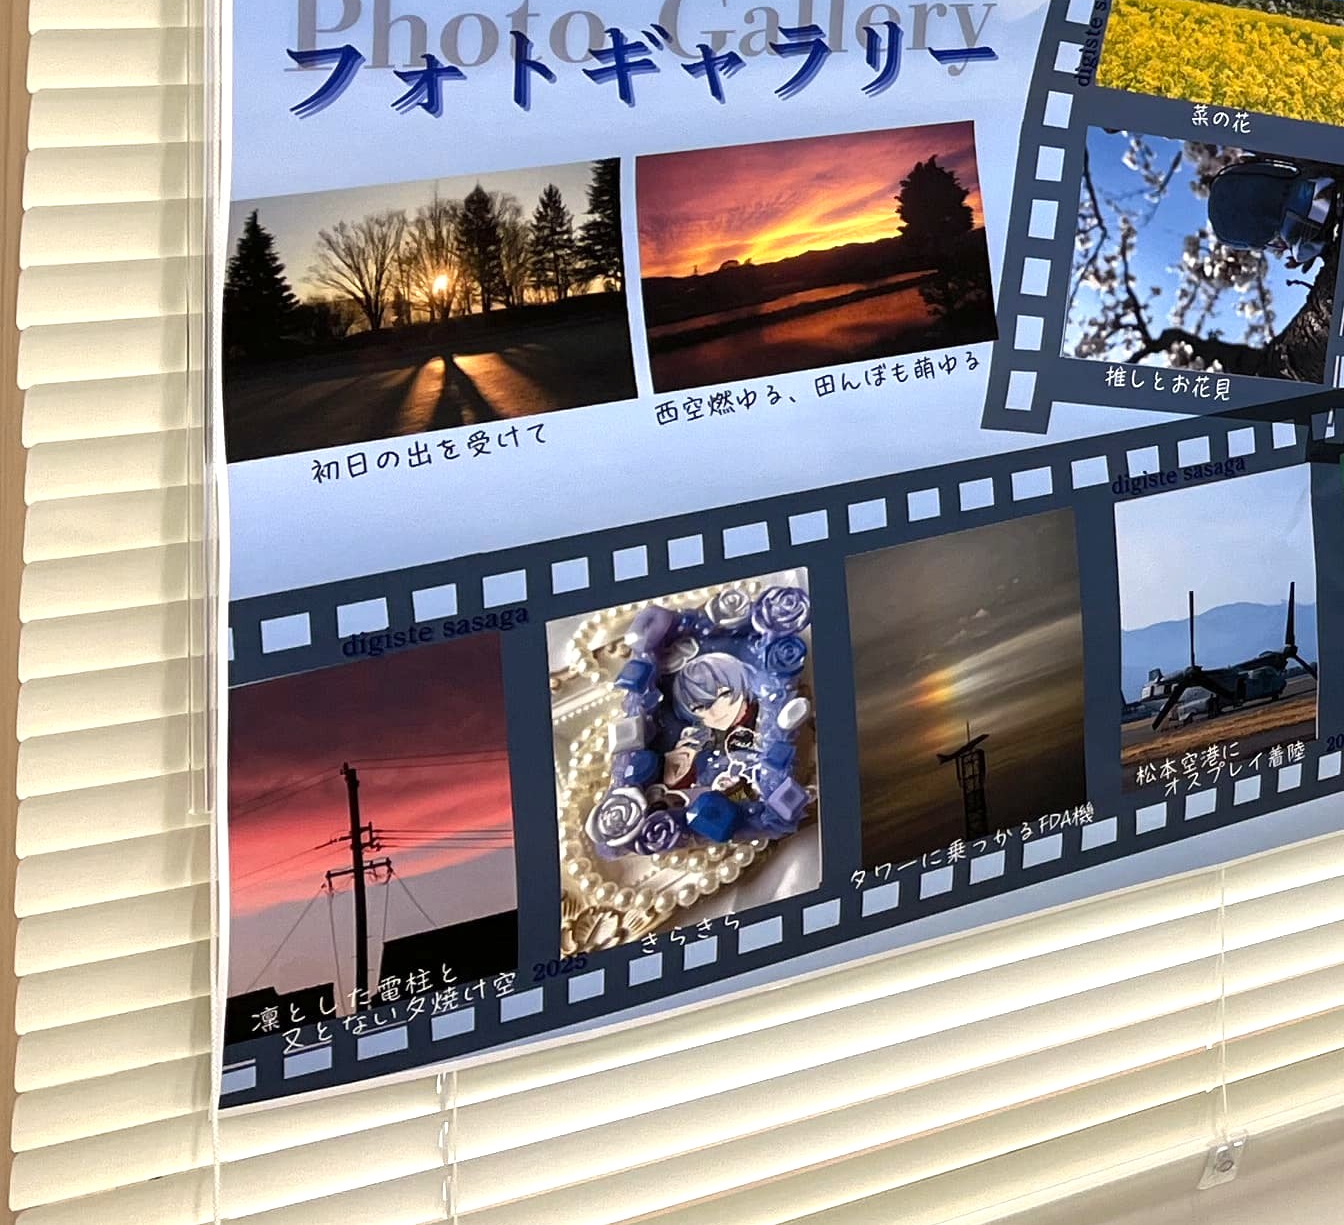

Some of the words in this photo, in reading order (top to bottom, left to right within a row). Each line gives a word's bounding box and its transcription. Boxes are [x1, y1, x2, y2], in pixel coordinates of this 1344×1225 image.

[285, 20, 999, 120] フォトギャラリー
[1191, 103, 1252, 135] 菜の花
[655, 348, 982, 428] 西空燃ゆる、田んぼも萌ゆる
[1104, 365, 1233, 402] 推しとお花見
[310, 421, 548, 485] 初日の出を受けて
[1112, 461, 1178, 496] digiste
[1183, 455, 1247, 484] sasaga
[340, 622, 435, 660] digiste
[441, 602, 531, 645] sasaga
[1135, 739, 1241, 785] 松本空港に
[1164, 738, 1307, 797] オスプレイ着陸
[849, 799, 1096, 891] タワーに乗っかるFDA機
[639, 911, 742, 955] きらきら
[532, 951, 589, 984] 2025
[282, 969, 518, 1054] 又とない夕焼け空
